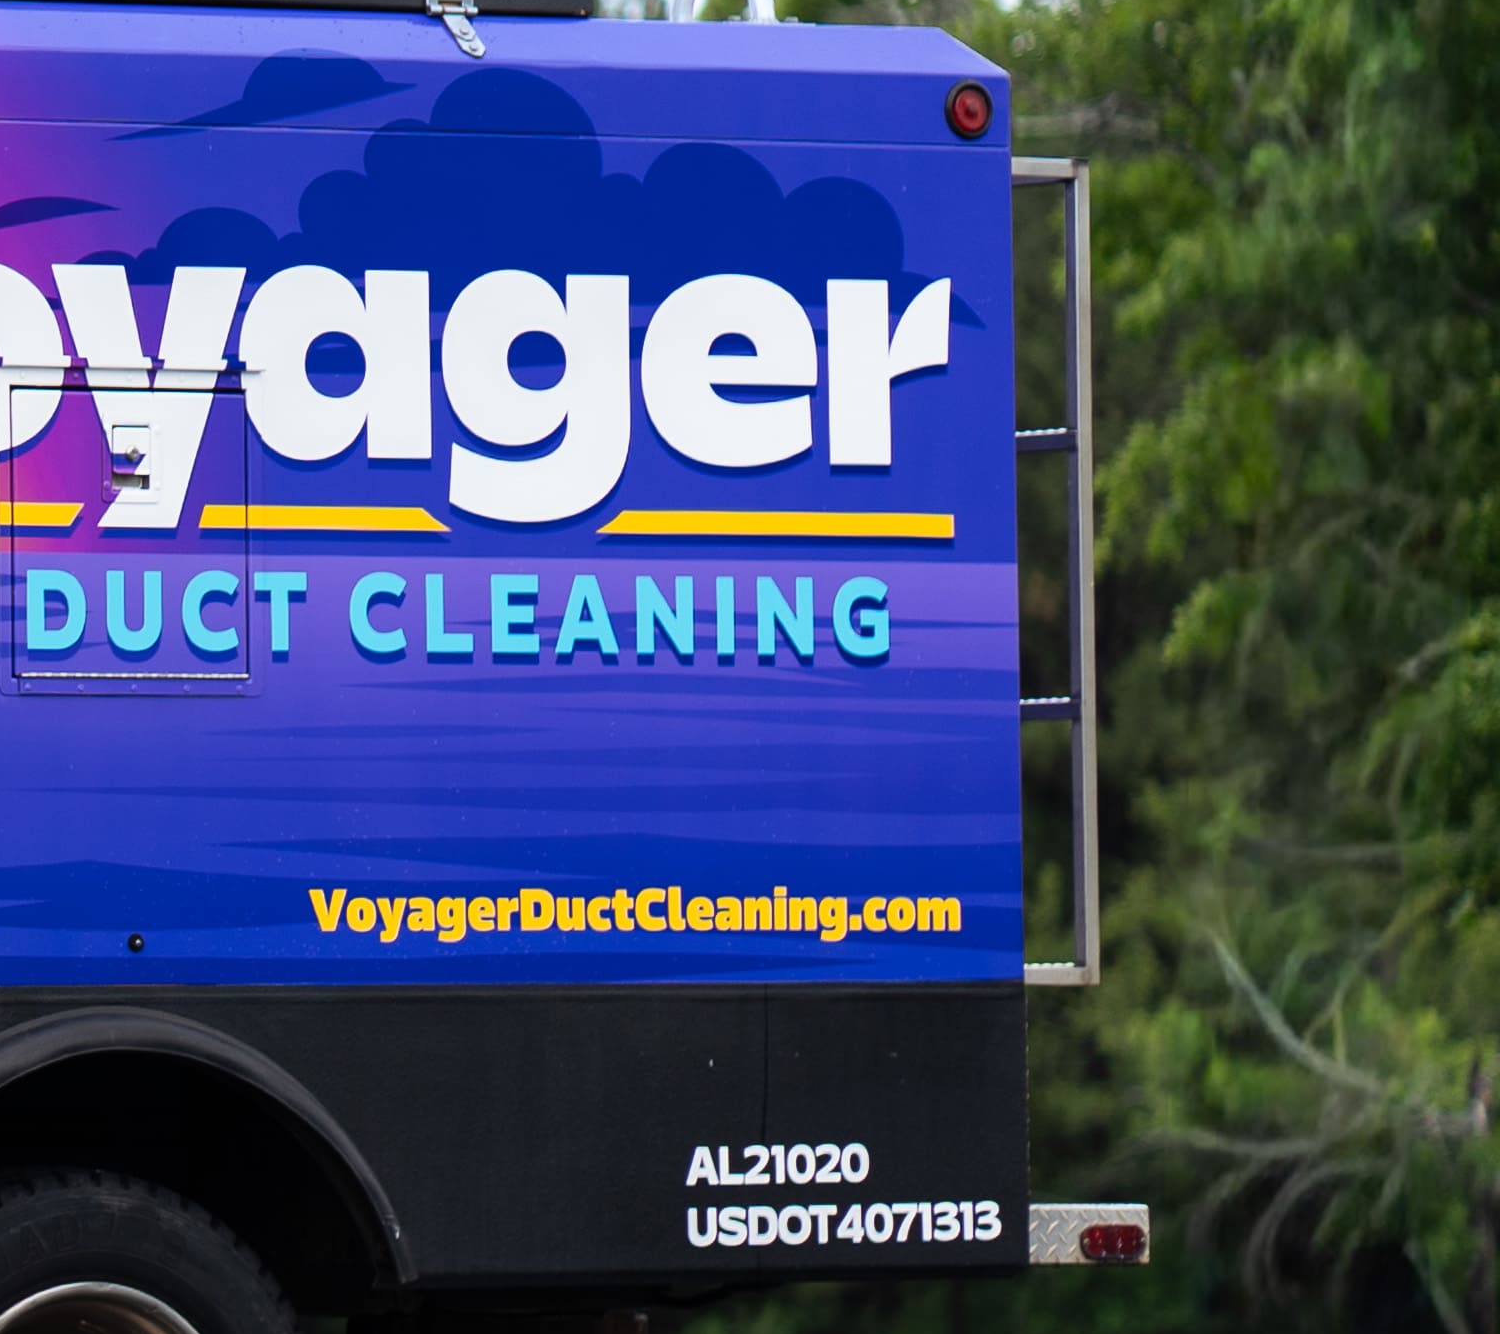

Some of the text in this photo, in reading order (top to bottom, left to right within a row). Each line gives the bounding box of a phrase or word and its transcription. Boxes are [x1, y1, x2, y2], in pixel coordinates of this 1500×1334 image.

[26, 569, 306, 658] DUCT
[350, 571, 892, 665] CLEANING
[308, 886, 962, 943] VoyagerDuctCleaning.com
[686, 1143, 870, 1186] AL21020
